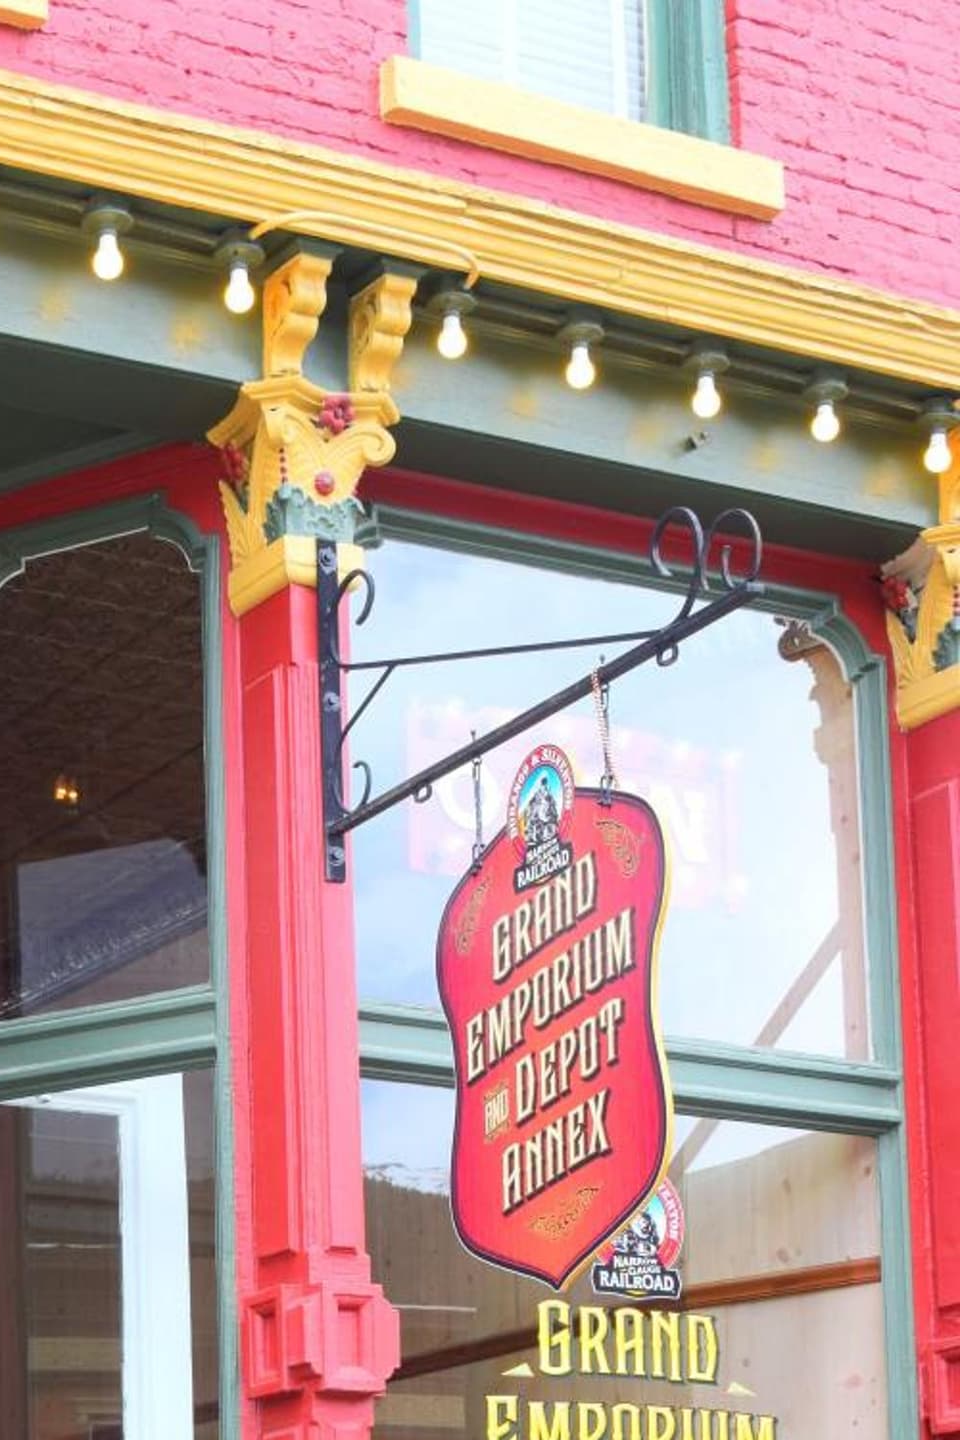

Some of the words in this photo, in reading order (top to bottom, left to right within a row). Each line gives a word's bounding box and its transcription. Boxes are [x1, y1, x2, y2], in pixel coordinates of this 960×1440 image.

[492, 854, 595, 981] GRAND
[517, 849, 570, 889] RAILROAD
[467, 910, 634, 1082] EMPORIUM
[484, 1088, 509, 1136] AND
[515, 1000, 622, 1122] DEPOT
[502, 1092, 609, 1211] ANNEX
[600, 1270, 675, 1292] RAILROAD
[537, 1300, 719, 1383] GRAND
